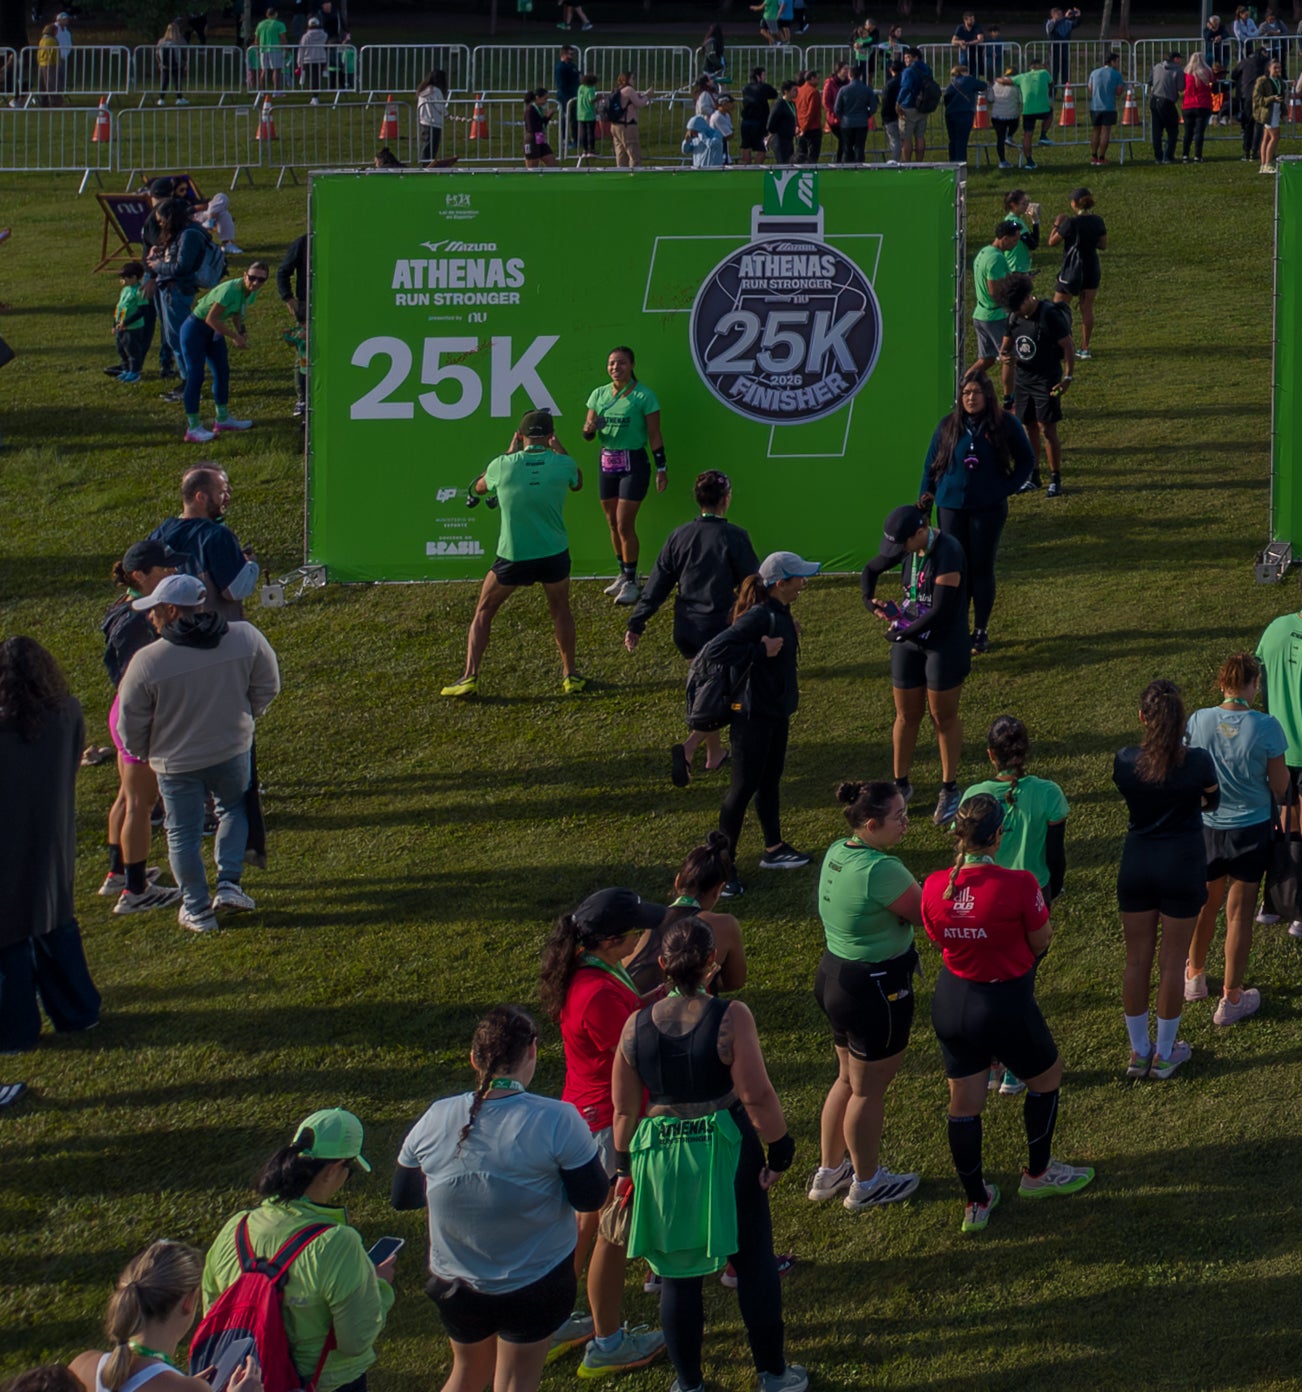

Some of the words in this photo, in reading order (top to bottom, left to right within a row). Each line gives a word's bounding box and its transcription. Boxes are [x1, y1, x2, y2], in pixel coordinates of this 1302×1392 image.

[391, 258, 525, 289] ATHENAS
[738, 254, 836, 278] ATHENAS
[742, 279, 767, 290] RUN
[769, 279, 832, 290] STRONGER
[395, 293, 429, 306] RUN
[434, 292, 520, 306] STRONGER
[705, 310, 865, 374] 25K
[350, 335, 562, 420] 25K
[771, 374, 802, 385] 2026
[729, 372, 850, 412] FINISHER
[426, 541, 485, 555] BRASIL
[953, 902, 974, 911] DLB
[944, 928, 987, 939] ATLETA
[660, 1118, 714, 1137] ATHENAS
